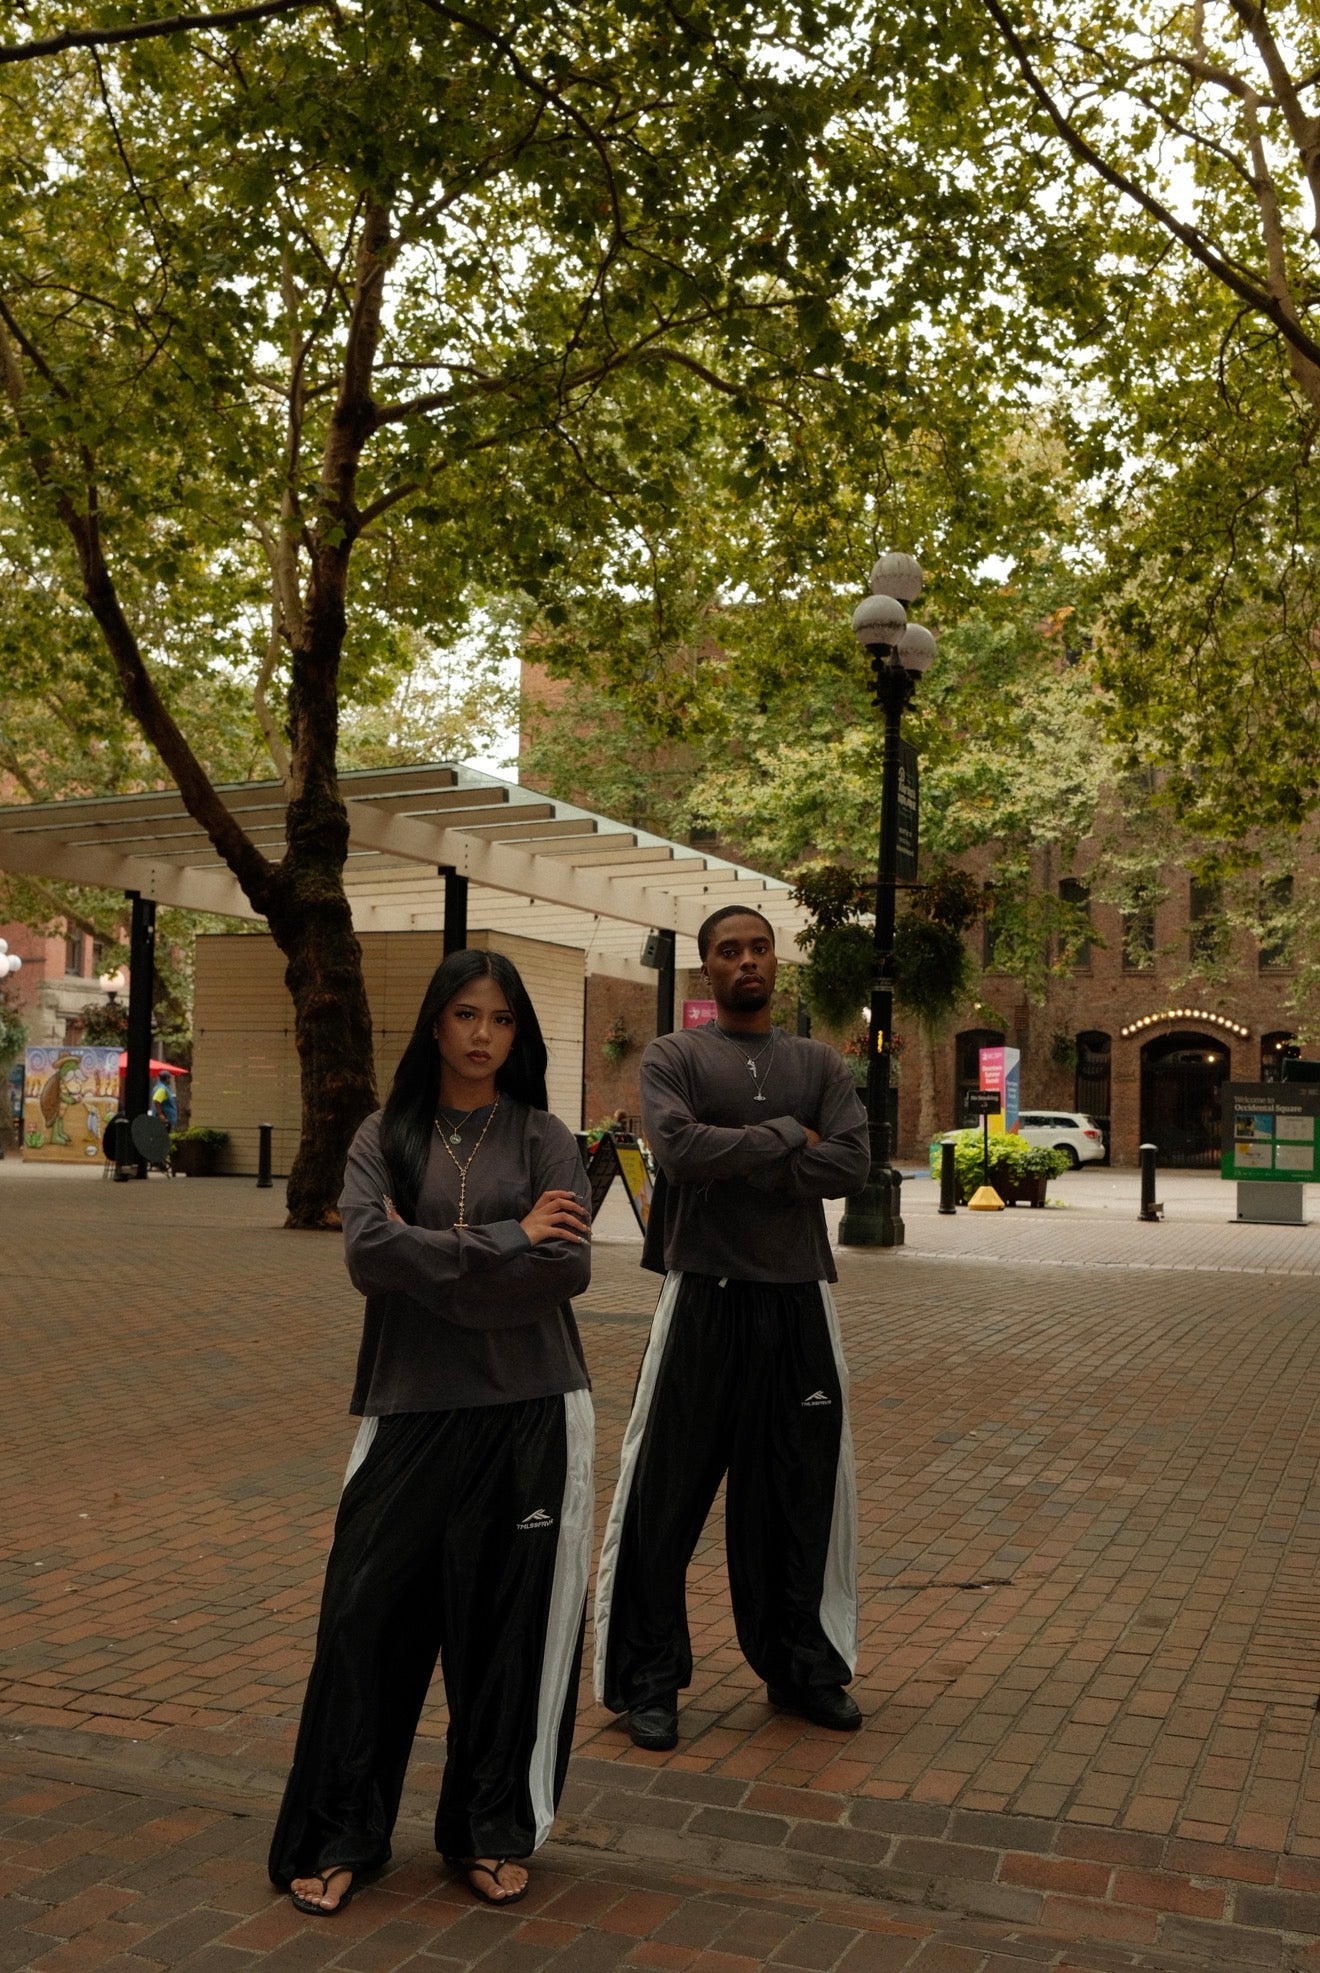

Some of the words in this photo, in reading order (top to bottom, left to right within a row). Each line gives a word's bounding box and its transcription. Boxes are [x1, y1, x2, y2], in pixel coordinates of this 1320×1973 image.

[1234, 1095, 1266, 1103] Welcome
[1234, 1103, 1274, 1112] Occidental
[1275, 1105, 1303, 1114] Square
